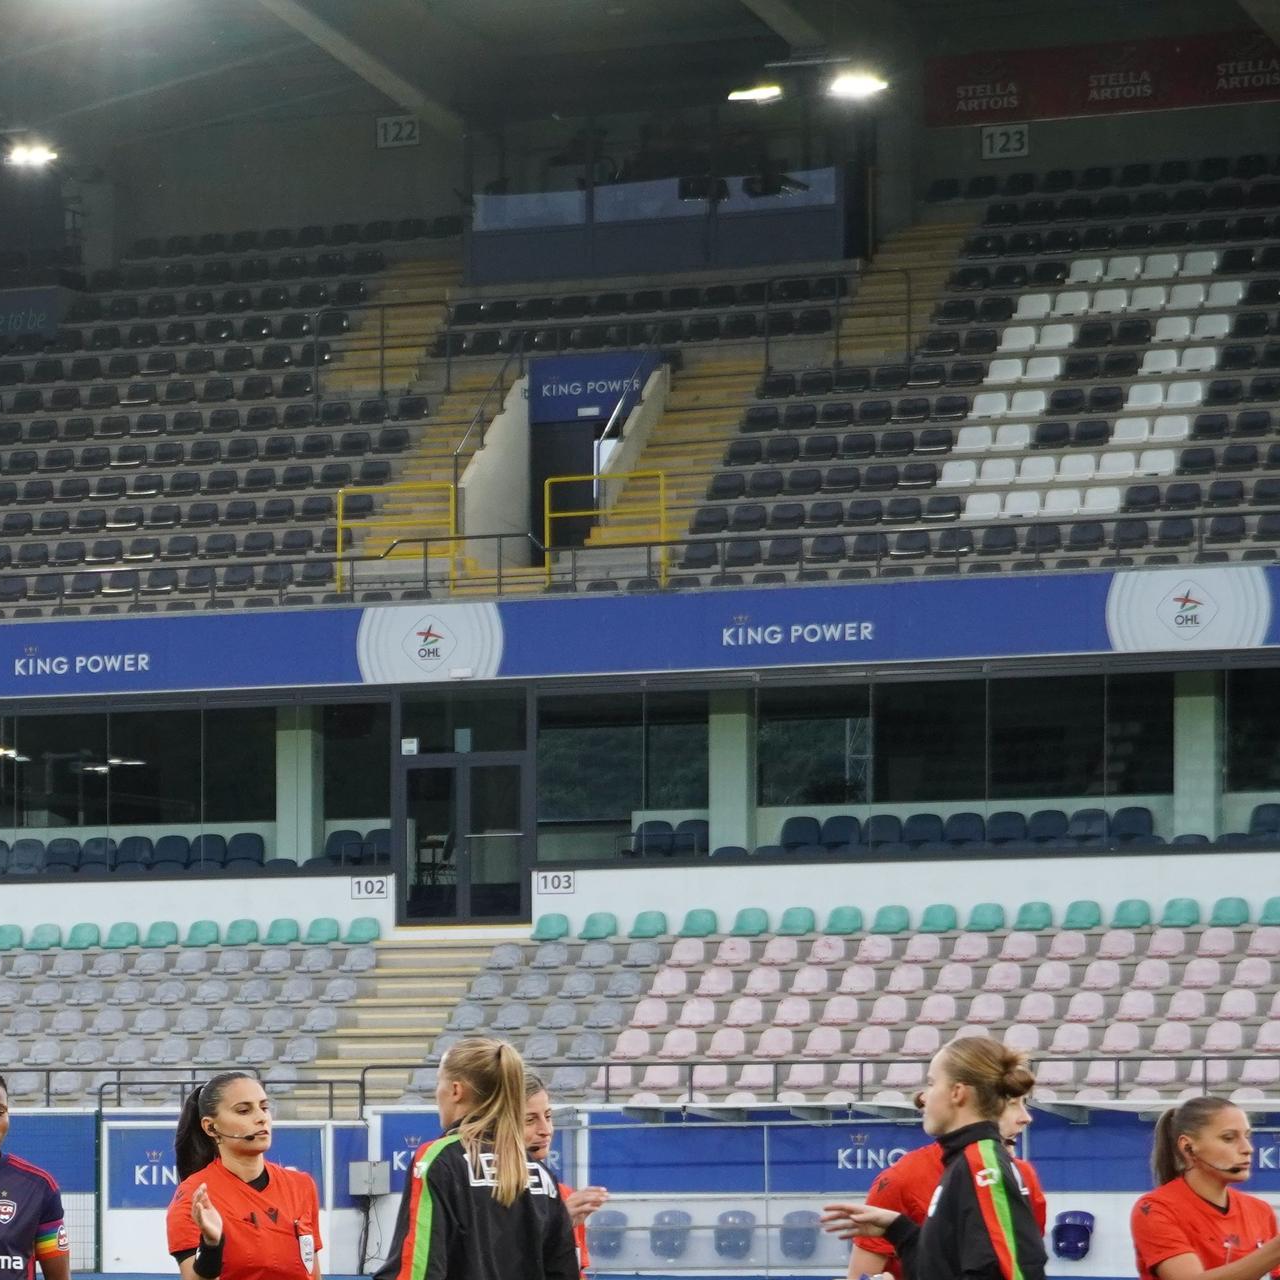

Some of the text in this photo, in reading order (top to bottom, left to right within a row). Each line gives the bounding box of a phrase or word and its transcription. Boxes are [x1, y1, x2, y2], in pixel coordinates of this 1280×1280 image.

[380, 120, 417, 144] 122
[983, 130, 1025, 153] 123
[542, 382, 582, 398] KING
[1174, 614, 1200, 626] OHL
[721, 622, 873, 647] KING POWER
[417, 647, 441, 659] OHL
[14, 653, 150, 677] KING POWER
[355, 880, 385, 895] 102
[541, 875, 572, 890] 103
[133, 1164, 178, 1186] KIN
